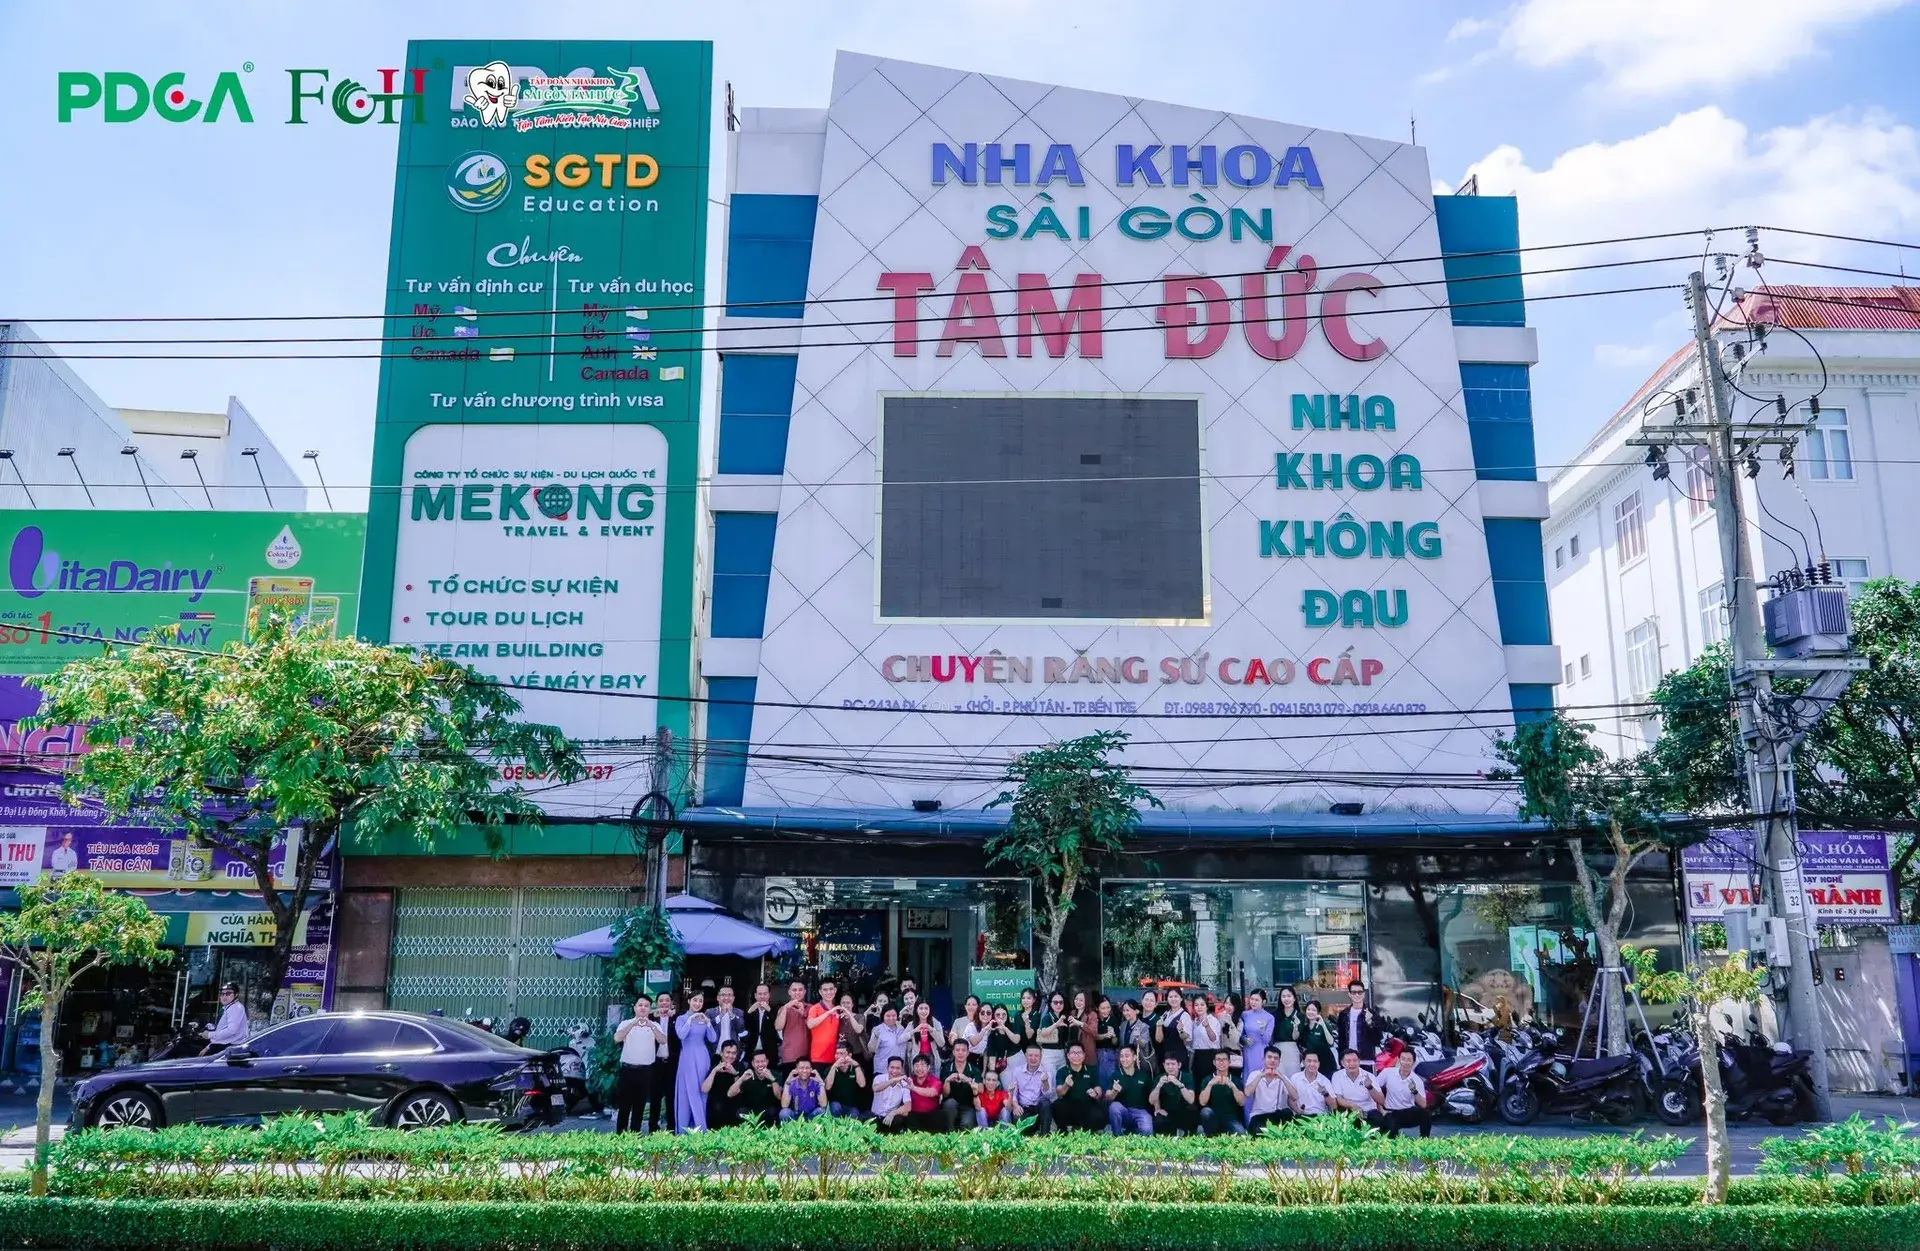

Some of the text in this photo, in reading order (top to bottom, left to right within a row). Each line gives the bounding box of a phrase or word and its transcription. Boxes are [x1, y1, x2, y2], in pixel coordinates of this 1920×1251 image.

[524, 154, 659, 188] SGTD
[931, 142, 1326, 190] NHA KHOA
[524, 196, 659, 212] Education
[986, 192, 1275, 243] SÀI GÒN
[487, 236, 583, 268] Chuyên
[406, 275, 543, 297] Tư vấn định cư
[568, 276, 694, 297] Tư vấn du học
[876, 245, 1389, 362] TÂM ĐỨC
[581, 366, 650, 382] Canada
[431, 393, 457, 407] Tư
[463, 391, 495, 408] vấn
[501, 393, 574, 411] chương
[580, 392, 621, 408] trình
[1290, 393, 1396, 431] NHA
[564, 471, 578, 479] DU
[1275, 452, 1423, 491] KHOA
[411, 483, 655, 521] MEKONG
[503, 525, 655, 537] TRAVEL & EVENT
[1259, 512, 1443, 559] KHÔNG
[428, 574, 619, 598] TỔ CHỨC SỰ KIỆN
[1300, 589, 1409, 628] ĐAU
[426, 611, 584, 629] TOUR DU LỊCH
[424, 643, 605, 658] TEAM BUILDING
[882, 645, 1384, 686] CHUYÊN RĂNG SỨ CAO CẤP
[510, 670, 541, 688] VÉ
[545, 670, 596, 689] MÁY
[600, 675, 648, 689] BAY
[8, 843, 36, 861] THU
[109, 842, 131, 855] HÓA
[1826, 840, 1866, 855] HÓA
[89, 856, 152, 873] TĂNG CÂN
[1790, 896, 1800, 907] 32
[220, 912, 245, 925] CỬA
[207, 928, 256, 943] NGHĨA
